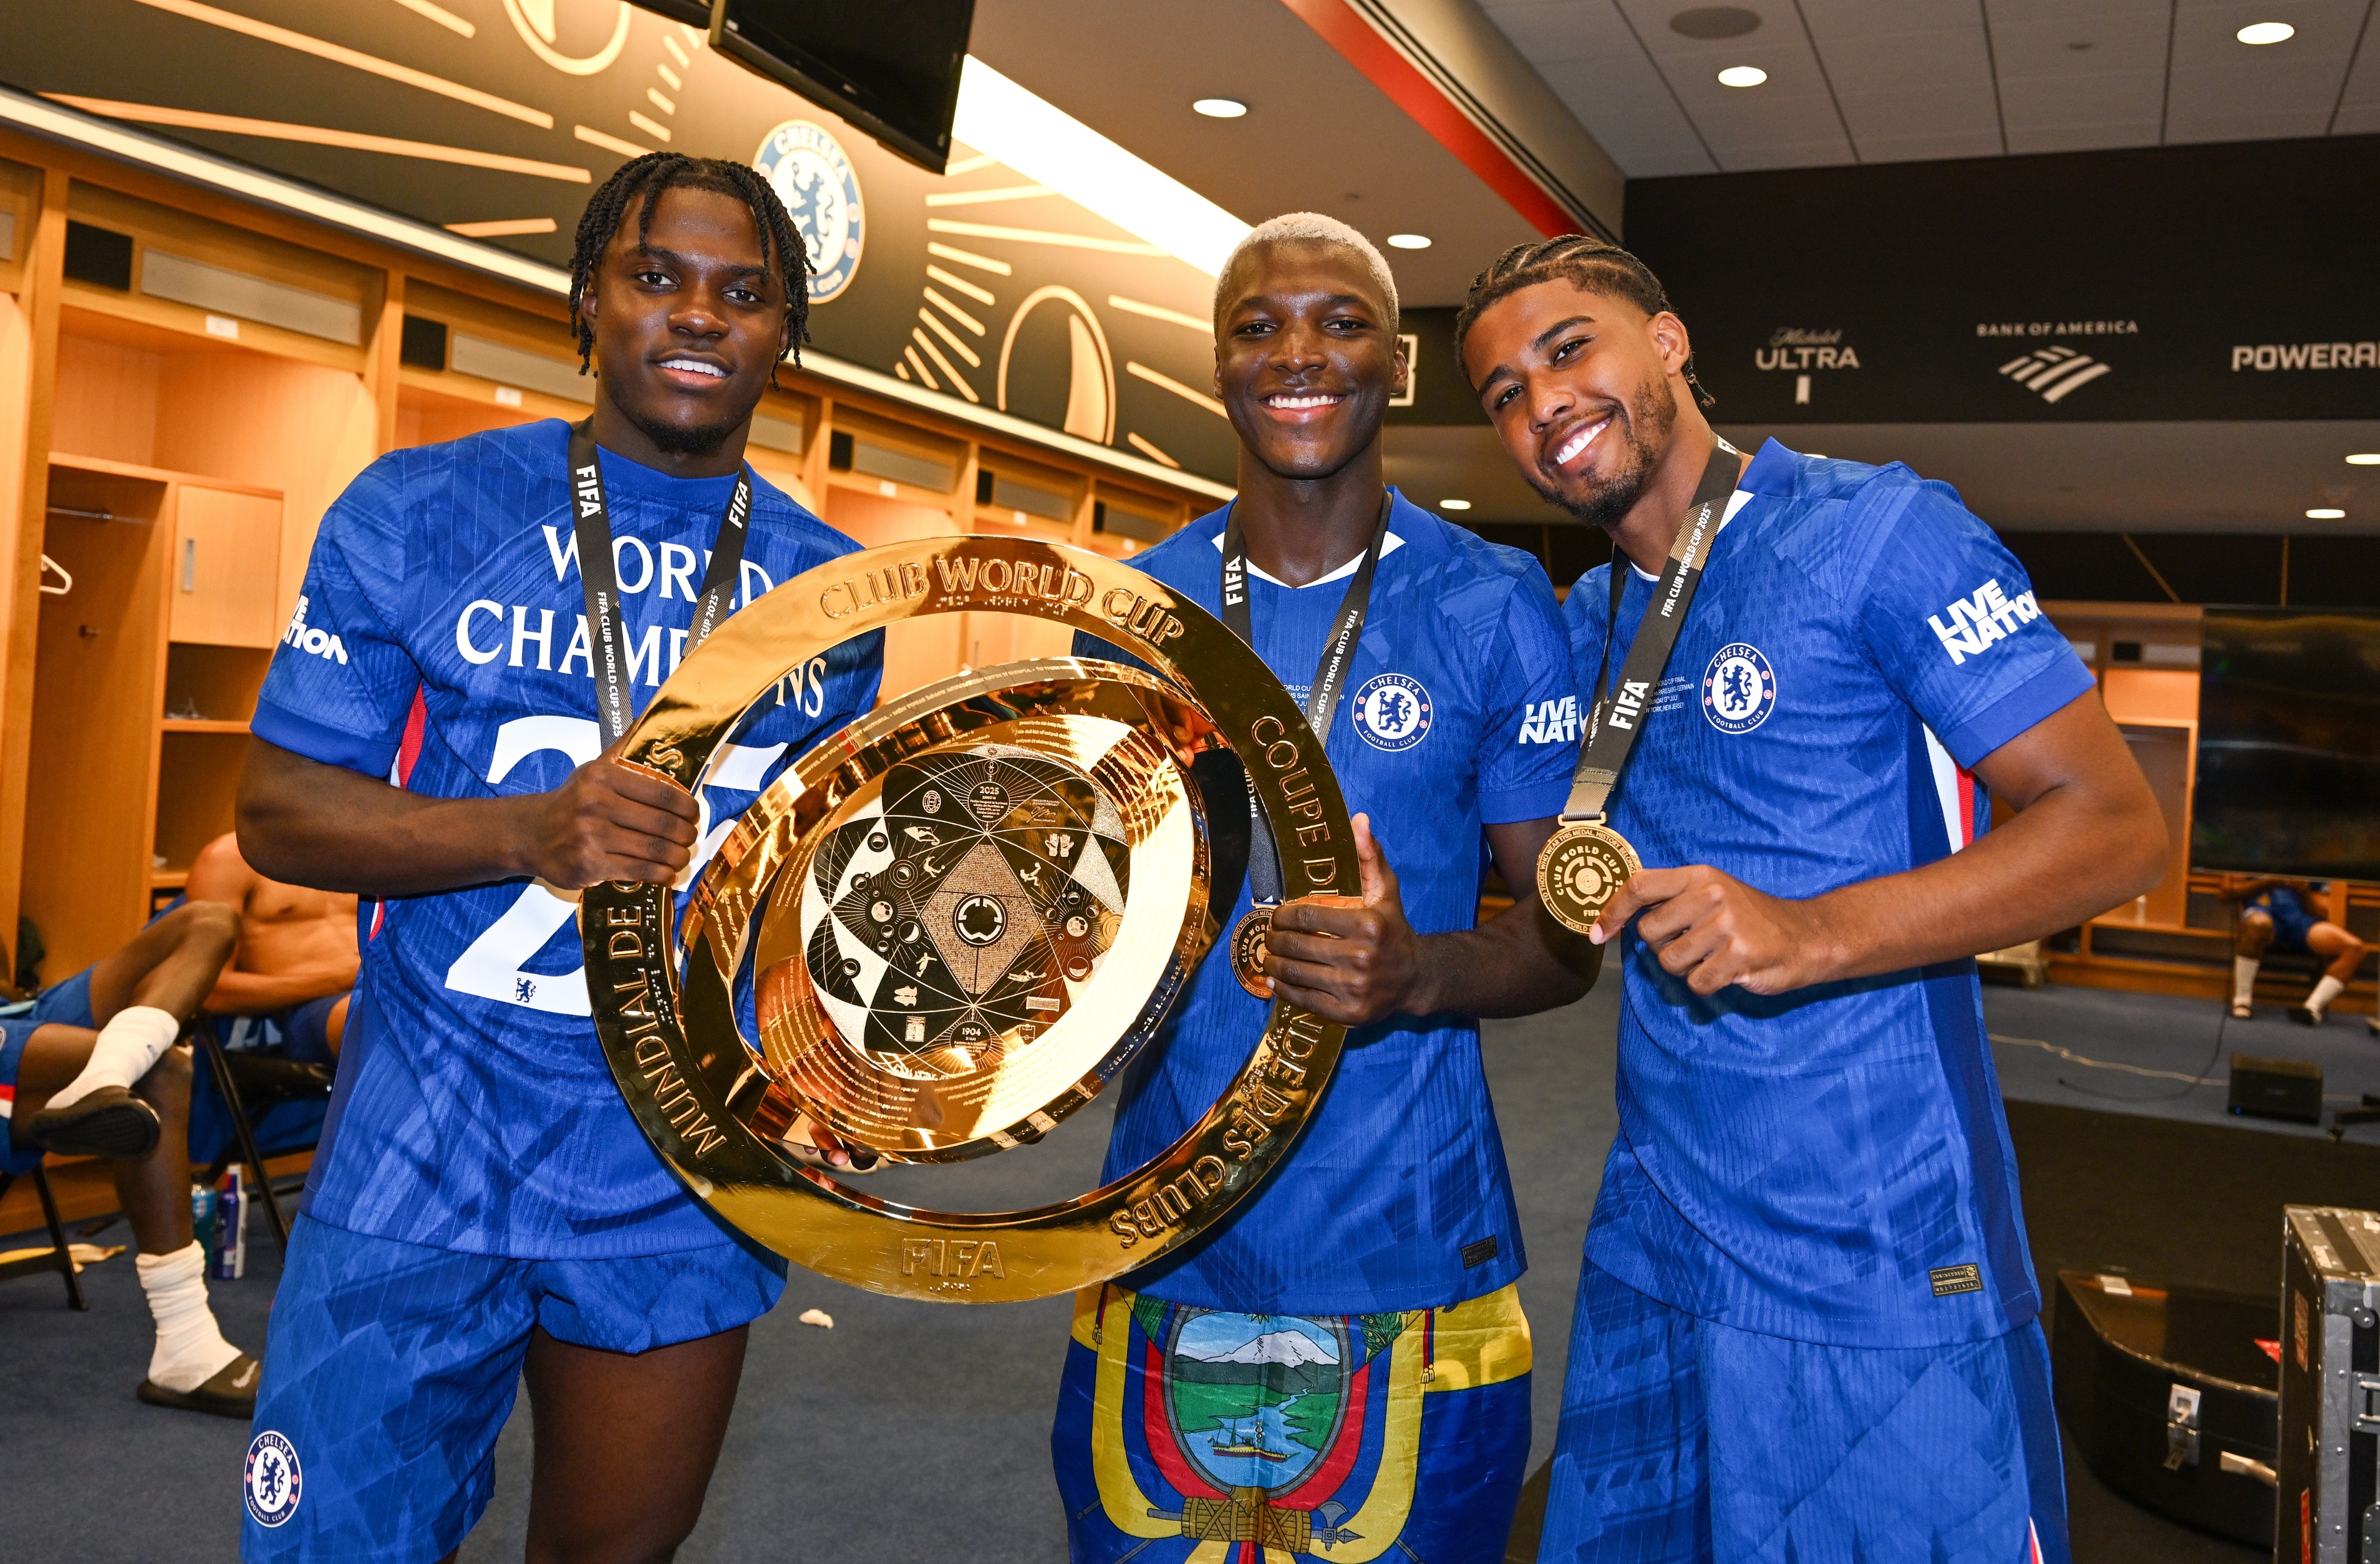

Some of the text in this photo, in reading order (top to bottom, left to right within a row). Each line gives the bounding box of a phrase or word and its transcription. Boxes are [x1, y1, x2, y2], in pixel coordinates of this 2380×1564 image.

[774, 126, 849, 183] CHELSEA
[1977, 320, 2139, 337] BANK OF AMERICA
[1755, 346, 1860, 371] ULTRA
[2231, 341, 2380, 372] POWERA
[576, 464, 601, 517] FIFA
[728, 482, 749, 529] FIFA
[1225, 555, 1243, 606] FIFA
[1661, 598, 1677, 618] FIFA
[1669, 575, 1685, 598] CLUB
[1677, 545, 1696, 576] WORLD
[1690, 529, 1703, 547] CUP
[820, 556, 1185, 646] CLUB WORLD CUP
[1927, 578, 2009, 642] LIVE
[700, 619, 711, 639] CUP
[1344, 609, 1358, 629] FIFA
[1942, 590, 2042, 666] NATION
[282, 618, 349, 665] TION
[1336, 630, 1350, 655] CLUB
[597, 591, 623, 737] FIFA CLUB WORLD CUP 2025
[1714, 647, 1757, 668] CHELSEA
[1323, 656, 1341, 691] WORLD
[1369, 676, 1420, 696] CHELSEA
[1667, 683, 1695, 693] SAINT-GERMAIN
[1318, 693, 1329, 714] CUP
[1523, 695, 1577, 724] LIVE
[1609, 681, 1650, 730] FIFA
[1671, 702, 1684, 710] JERSEY
[1518, 717, 1577, 744] NAT
[1713, 710, 1764, 729] FOOTBALL CLUB
[1363, 730, 1416, 747] FOOTBALL CLUB
[979, 786, 1000, 795] 2025
[1252, 715, 1331, 847] COUPE
[1249, 795, 1258, 818] FIFA
[1545, 839, 1560, 855] WEAR
[1559, 832, 1572, 842] THIS
[1596, 831, 1621, 850] HISTORY
[1539, 854, 1549, 870] WHO
[1553, 865, 1564, 896] CLUB
[1560, 846, 1600, 863] WORLD
[1603, 853, 1621, 874] CUP
[1618, 845, 1638, 874] BELONGS
[1542, 892, 1550, 902] TO
[607, 906, 644, 960] DE
[1566, 919, 1588, 931] WORLD
[1232, 957, 1237, 966] TO
[1239, 916, 1251, 928] WEAR
[1241, 924, 1272, 963] CLUB WORL
[1245, 982, 1260, 995] WORLD
[962, 1027, 982, 1036] 1904
[614, 967, 727, 1159] MUNDIAL
[1223, 1083, 1292, 1161] DES
[1110, 1154, 1228, 1249] CLUBS
[901, 1237, 1006, 1279] FIFA
[258, 1435, 294, 1463] CHELSEA
[249, 1495, 285, 1522] FOOTBALL CLUB
